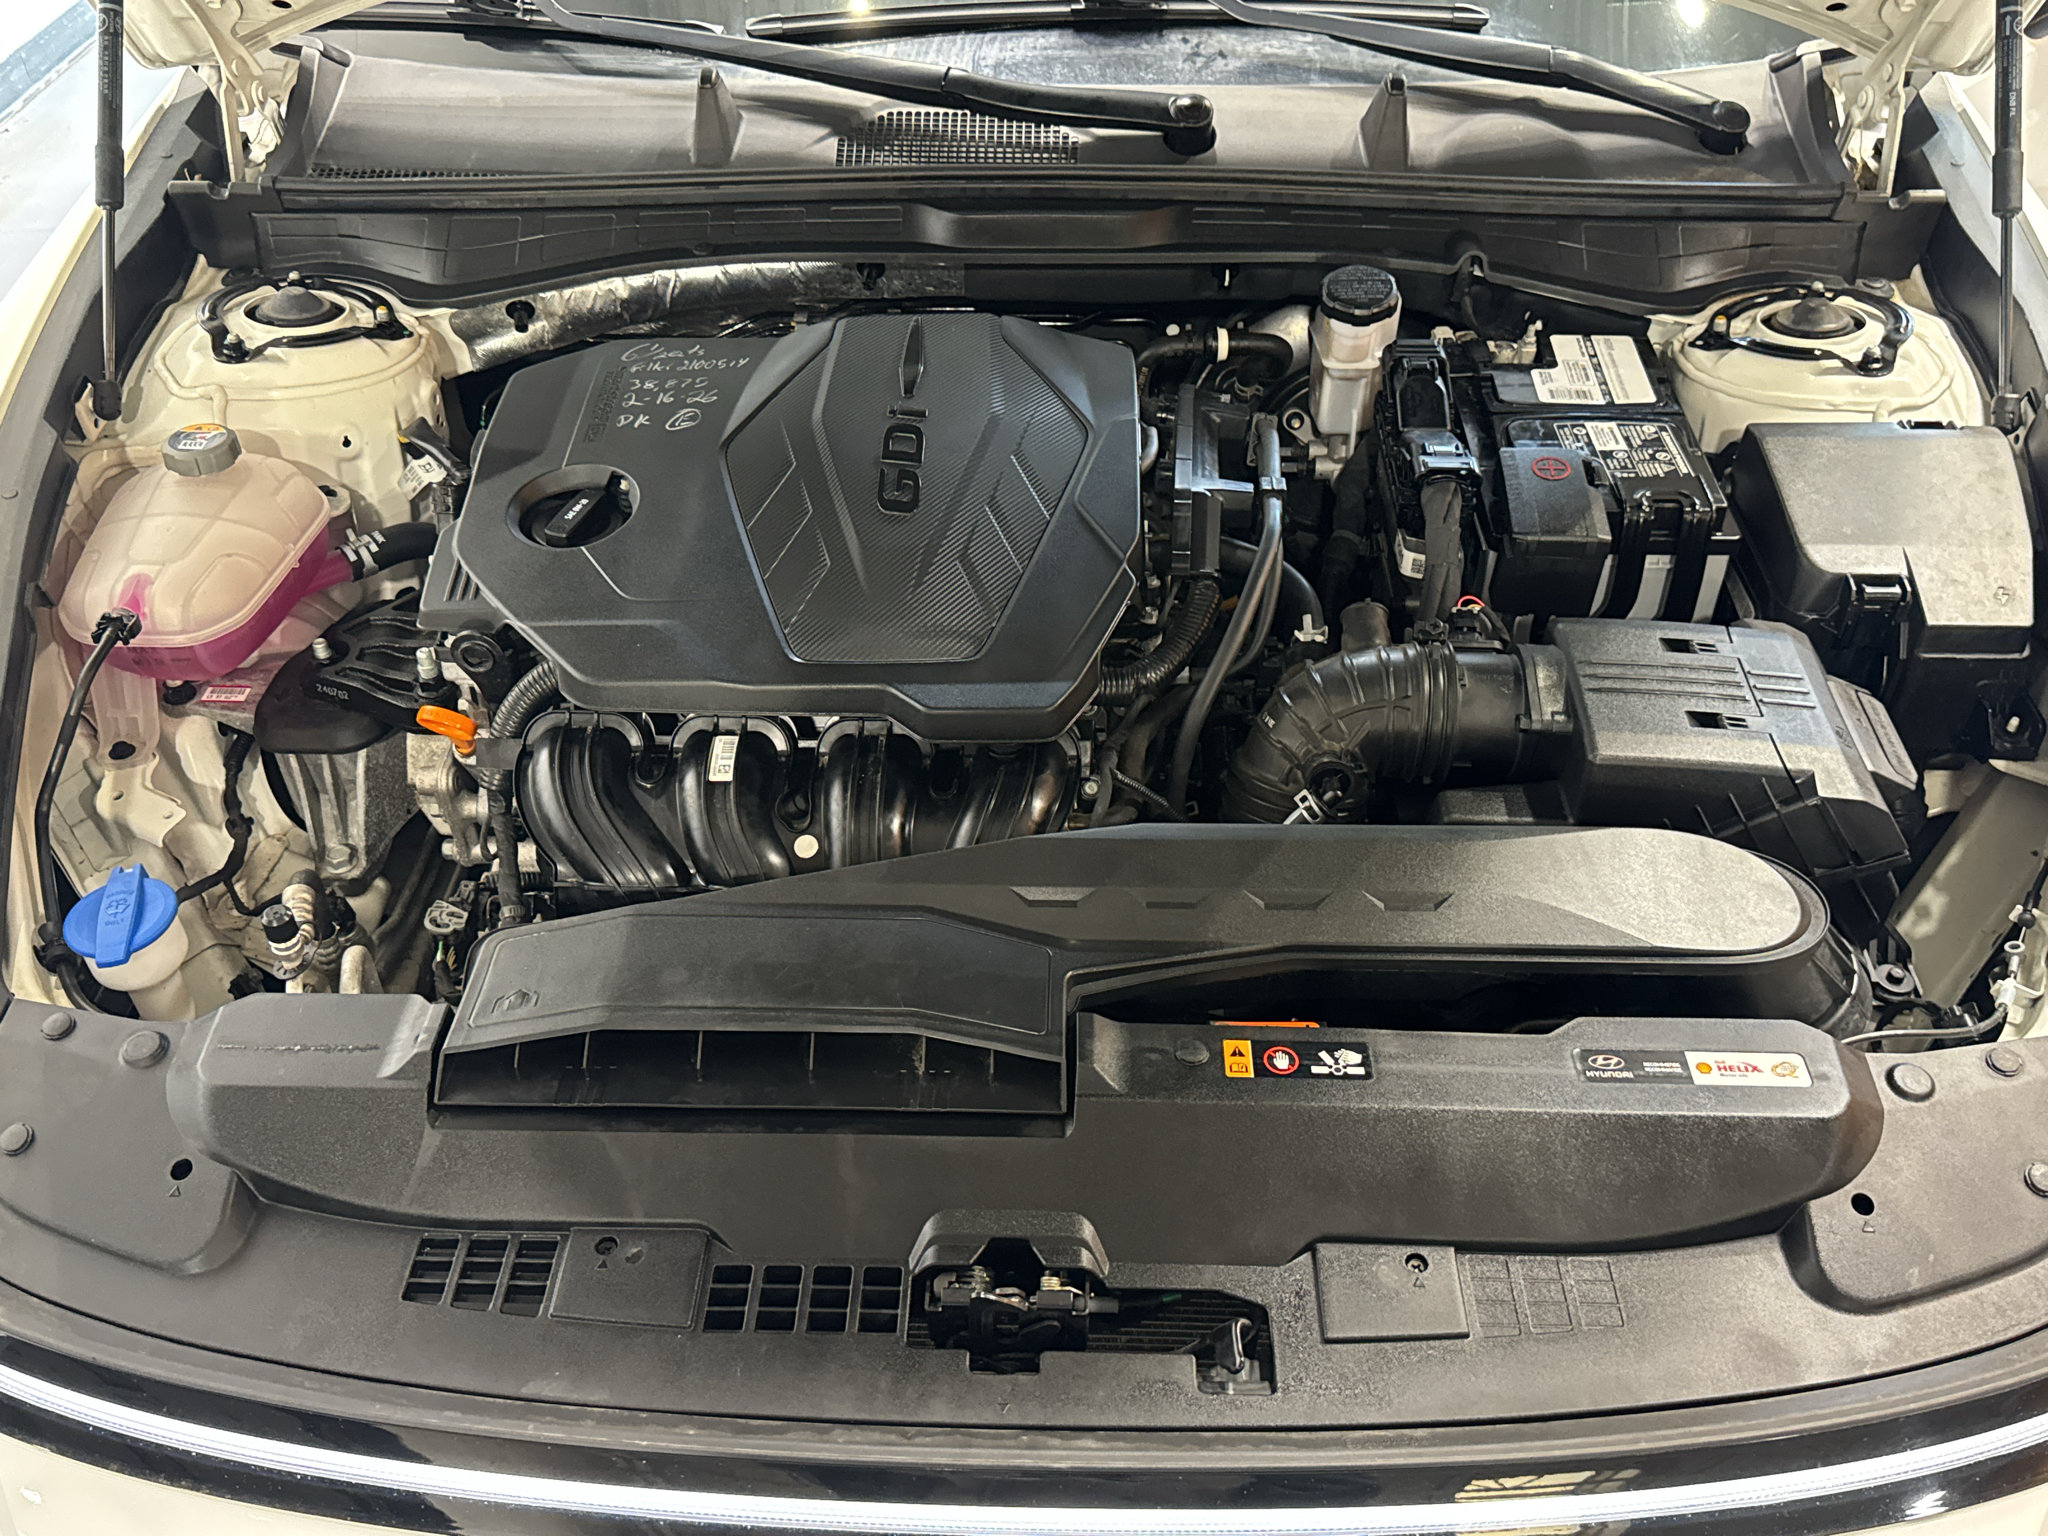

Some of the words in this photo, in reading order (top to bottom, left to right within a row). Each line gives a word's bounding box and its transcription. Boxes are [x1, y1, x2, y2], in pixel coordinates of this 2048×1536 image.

[877, 403, 929, 515] GDi
[1716, 1063, 1764, 1073] HELIX
[1585, 1070, 1634, 1079] HYUNDAI
